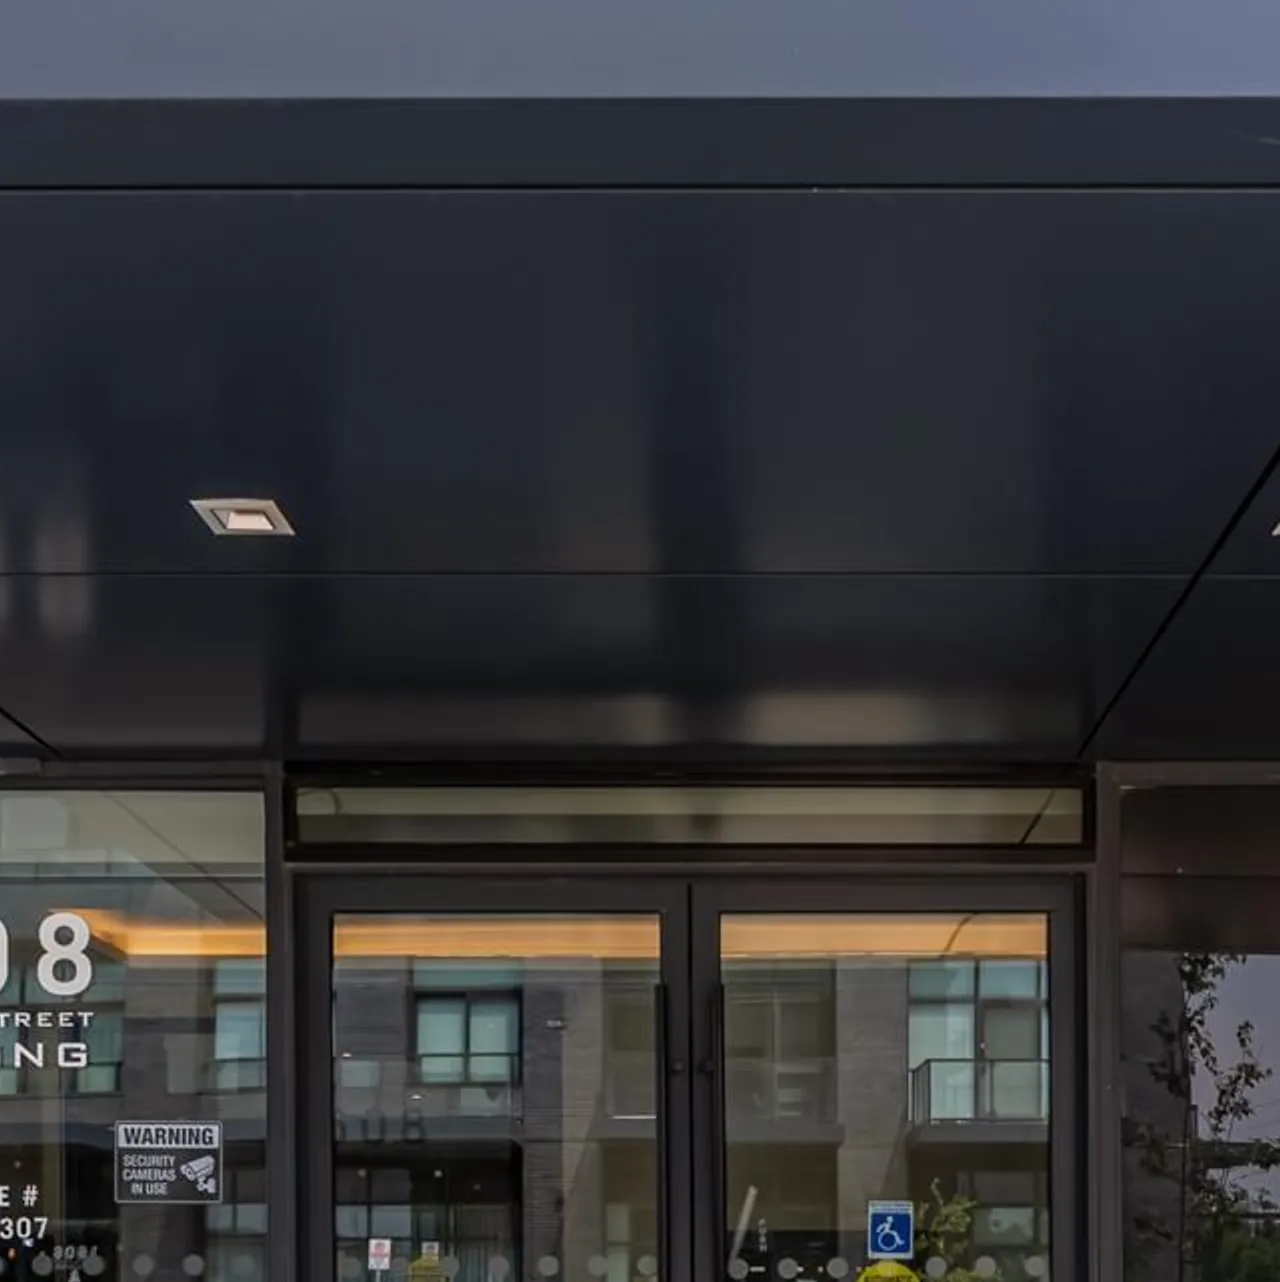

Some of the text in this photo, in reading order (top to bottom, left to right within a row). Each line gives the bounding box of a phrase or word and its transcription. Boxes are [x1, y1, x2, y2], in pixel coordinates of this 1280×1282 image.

[123, 1127, 214, 1145] WARNING
[123, 1154, 176, 1167] SECURITY
[122, 1168, 177, 1181] CAMERAS
[131, 1182, 168, 1195] IN USE
[23, 1185, 38, 1207] #
